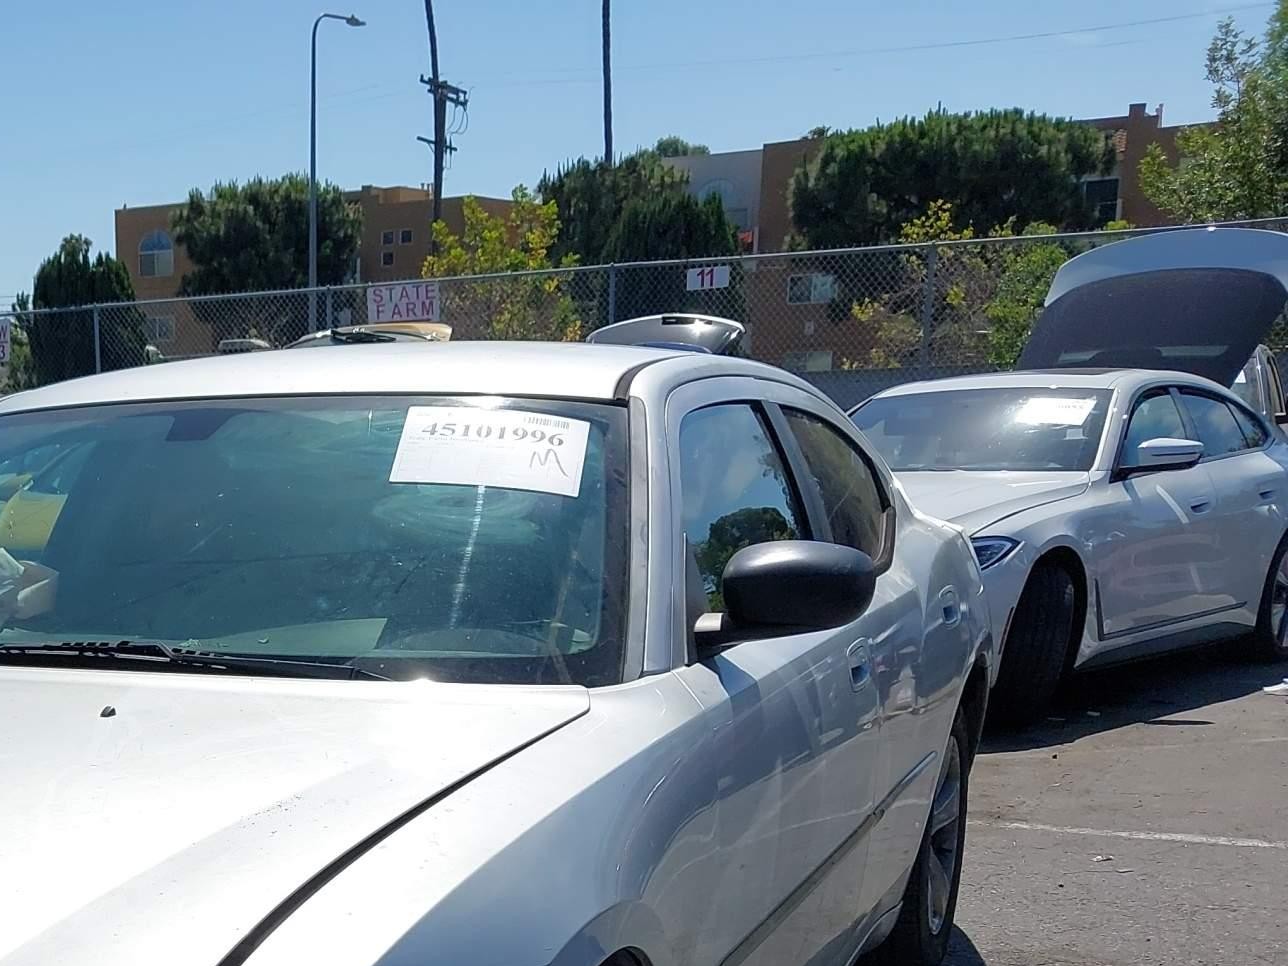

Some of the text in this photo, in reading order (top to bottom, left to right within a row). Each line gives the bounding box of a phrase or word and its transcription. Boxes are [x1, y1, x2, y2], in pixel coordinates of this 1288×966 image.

[696, 268, 714, 288] 11
[372, 283, 437, 304] STATE
[376, 301, 434, 320] FARM
[421, 422, 564, 447] 45101996
